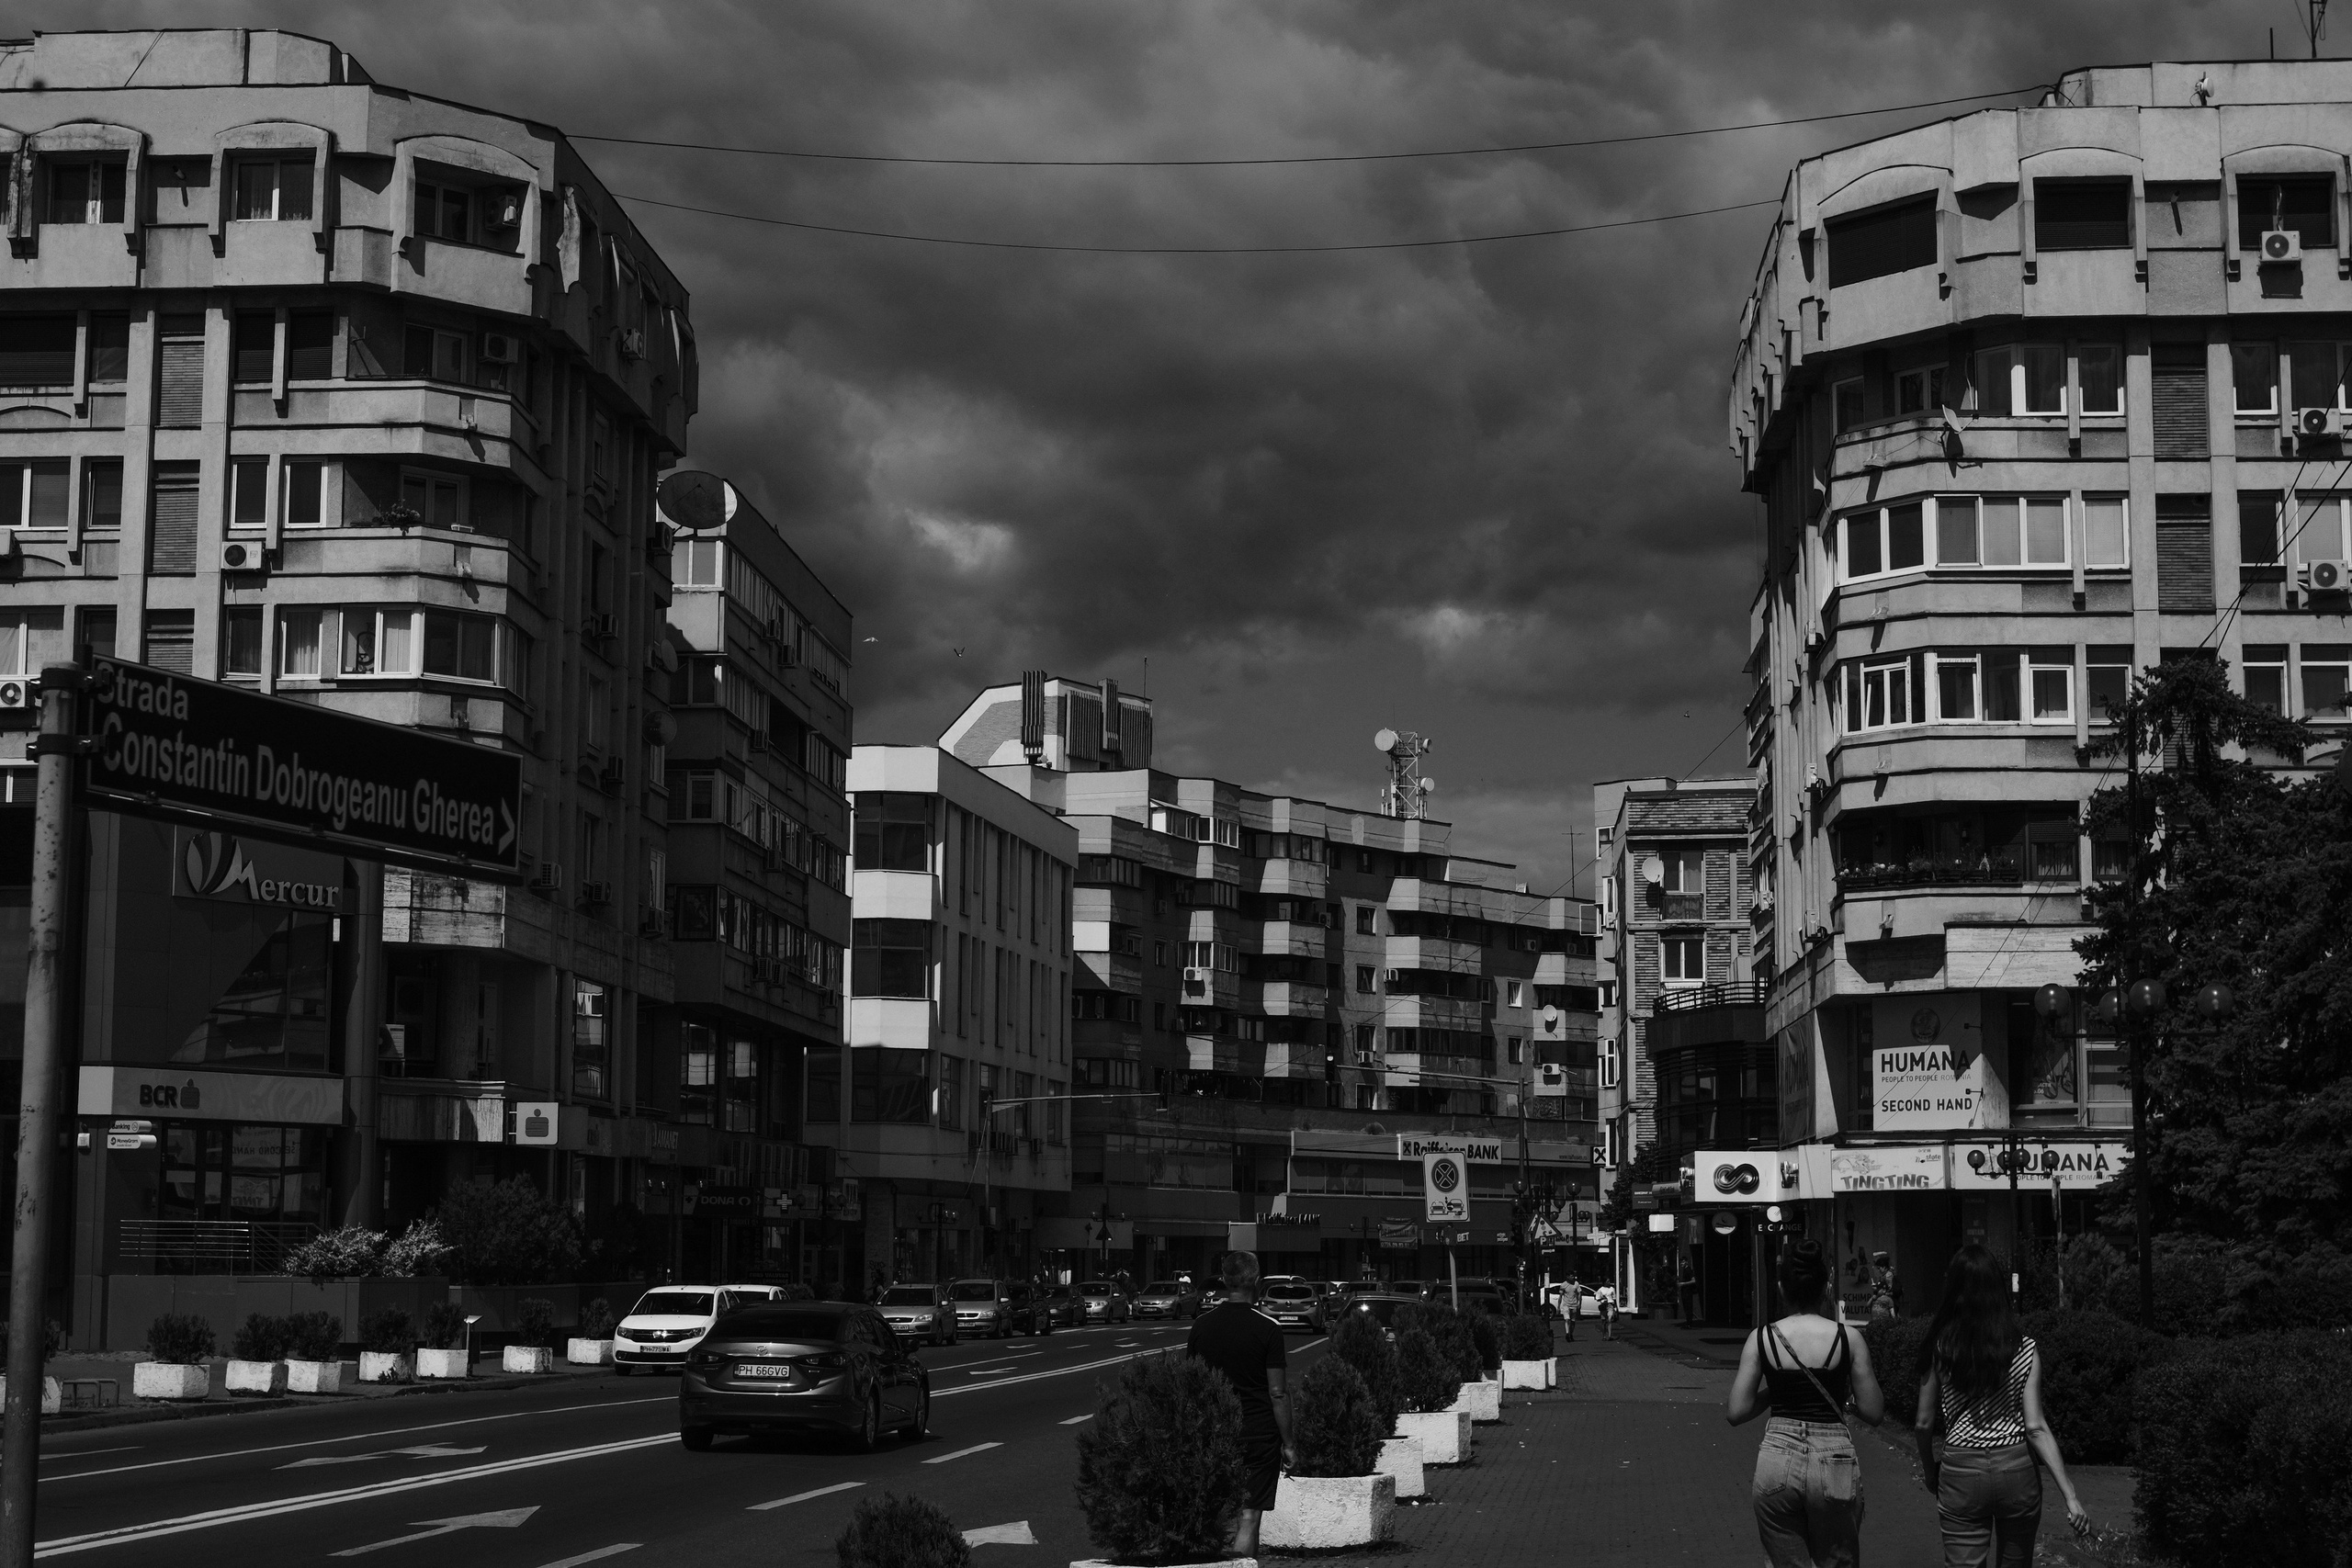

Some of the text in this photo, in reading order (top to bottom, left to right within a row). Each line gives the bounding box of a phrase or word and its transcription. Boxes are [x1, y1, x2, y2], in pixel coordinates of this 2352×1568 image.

[97, 661, 188, 721] Strada
[103, 712, 494, 846] Constantin Dobrogeanu Gherea
[208, 839, 340, 908] Mercur
[1881, 1050, 1972, 1073] HUMANA
[140, 1084, 177, 1108] BCR
[1881, 1098, 1973, 1112] SECOND HAND
[1467, 1144, 1499, 1159] BANK
[700, 1196, 735, 1205] DONA
[739, 1365, 788, 1376] PH 66GVG
